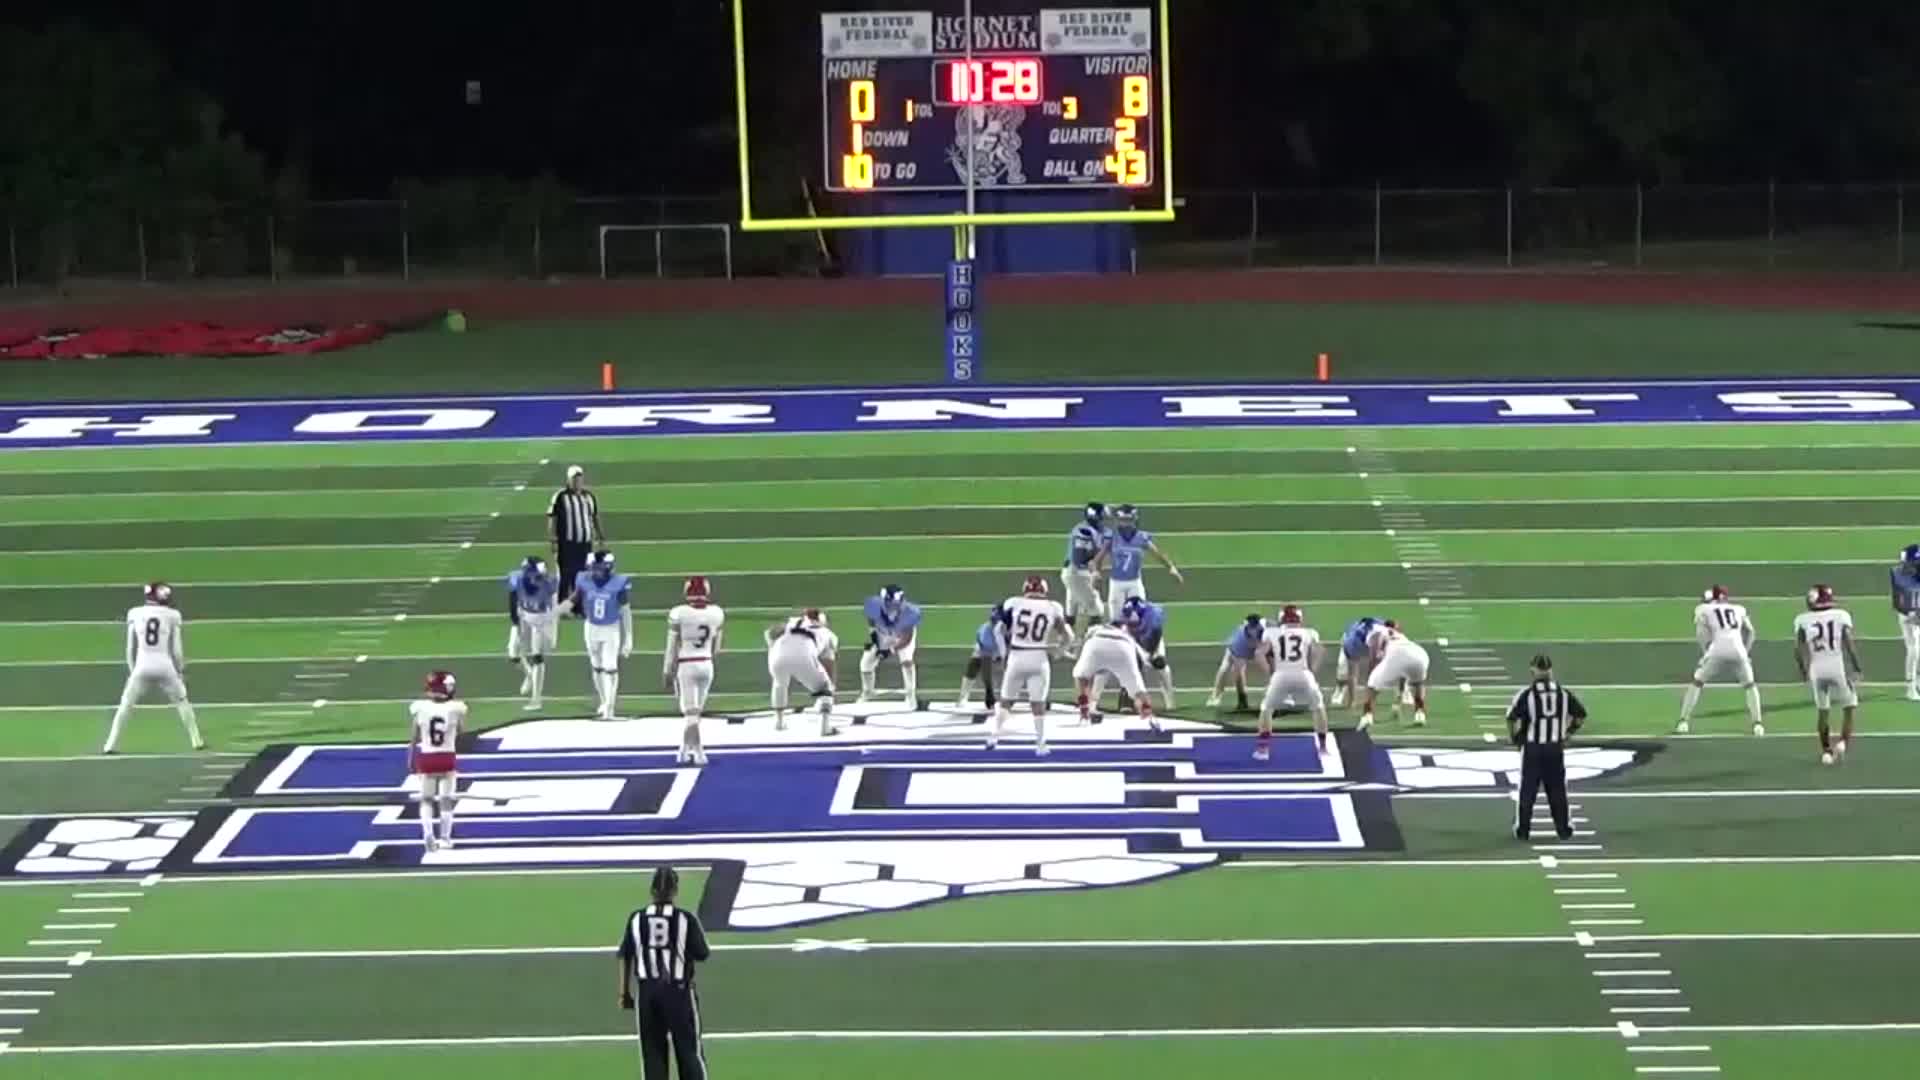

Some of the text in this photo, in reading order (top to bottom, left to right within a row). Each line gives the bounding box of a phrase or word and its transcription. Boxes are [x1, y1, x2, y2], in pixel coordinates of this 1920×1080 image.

[936, 16, 1033, 32] HORNET
[1064, 26, 1128, 37] FEDERAL
[827, 60, 879, 79] HOME
[1085, 56, 1148, 75] VISITOR
[850, 81, 875, 121] 0
[1062, 96, 1078, 120] 3
[1124, 76, 1148, 117] 8
[864, 131, 909, 147] DOWN
[1049, 117, 1136, 151] QUARTER 2
[875, 163, 891, 179] TO
[895, 162, 917, 178] GO
[1043, 150, 1147, 185] BALL ON 43
[952, 264, 973, 380] HOOKS
[0, 391, 1916, 438] HORNETS
[145, 617, 160, 647] 8
[1016, 610, 1049, 643] 50
[1811, 620, 1835, 652] 21
[1278, 636, 1303, 662] 13
[1540, 692, 1557, 717] U
[429, 717, 445, 747] 6
[648, 916, 670, 947] B
